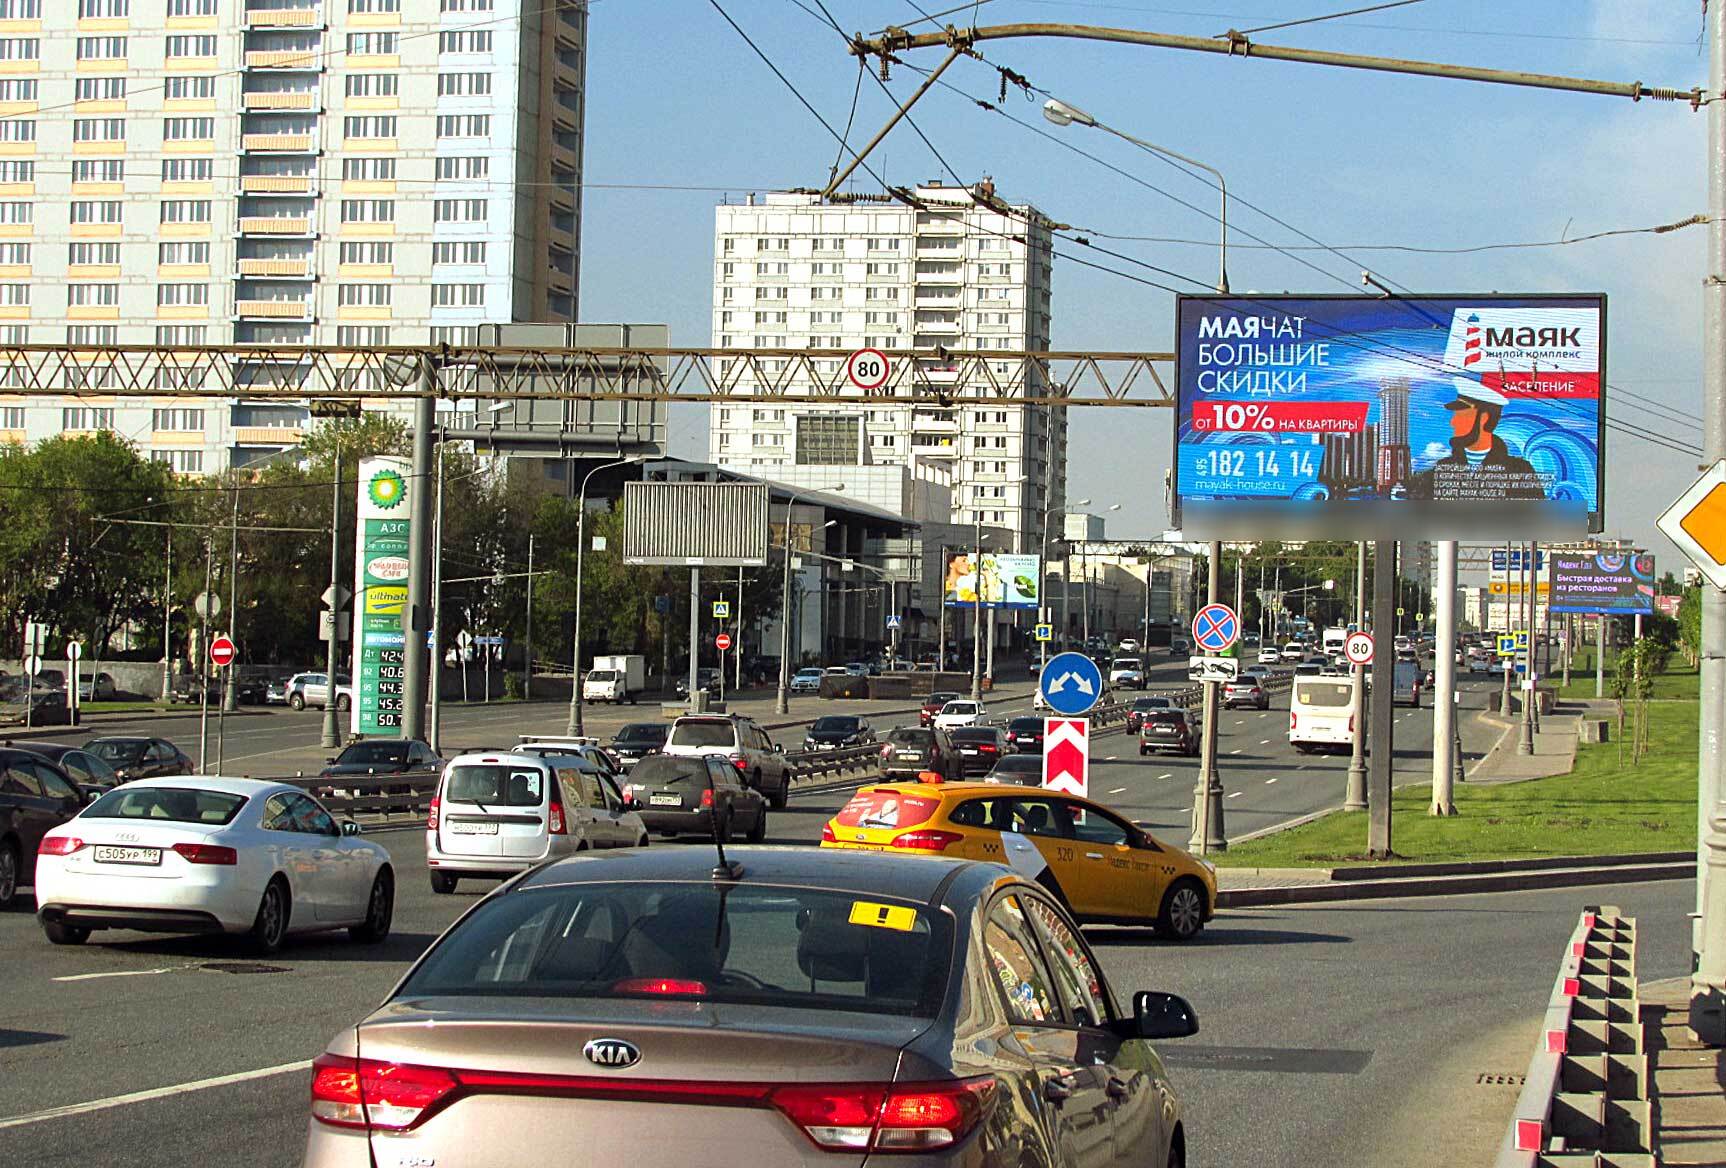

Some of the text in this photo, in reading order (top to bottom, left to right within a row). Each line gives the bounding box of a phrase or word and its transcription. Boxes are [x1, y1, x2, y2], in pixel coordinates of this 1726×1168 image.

[1198, 316, 1306, 339] МАЯЧАТ
[1198, 344, 1330, 366] БОЛЬШИЕ
[1486, 350, 1581, 359] жилой комплекс
[857, 361, 880, 377] 80
[1197, 370, 1307, 397] СКИДКИ
[1501, 381, 1575, 393] ЗАСЕЛЕНИЕ
[1212, 404, 1275, 430] 10%
[1279, 418, 1296, 430] НА
[1208, 449, 1245, 477] 182
[1255, 450, 1279, 477] 14
[1289, 450, 1314, 478] 14
[1195, 479, 1286, 492] mayak-house.ru
[380, 523, 405, 533] АЗС
[1556, 573, 1633, 584] Быстрая доставка
[1568, 585, 1618, 593] ресторанов
[1352, 642, 1368, 654] 80
[142, 849, 158, 858] 199
[1057, 846, 1074, 862] 320
[592, 1044, 631, 1064] KIA
